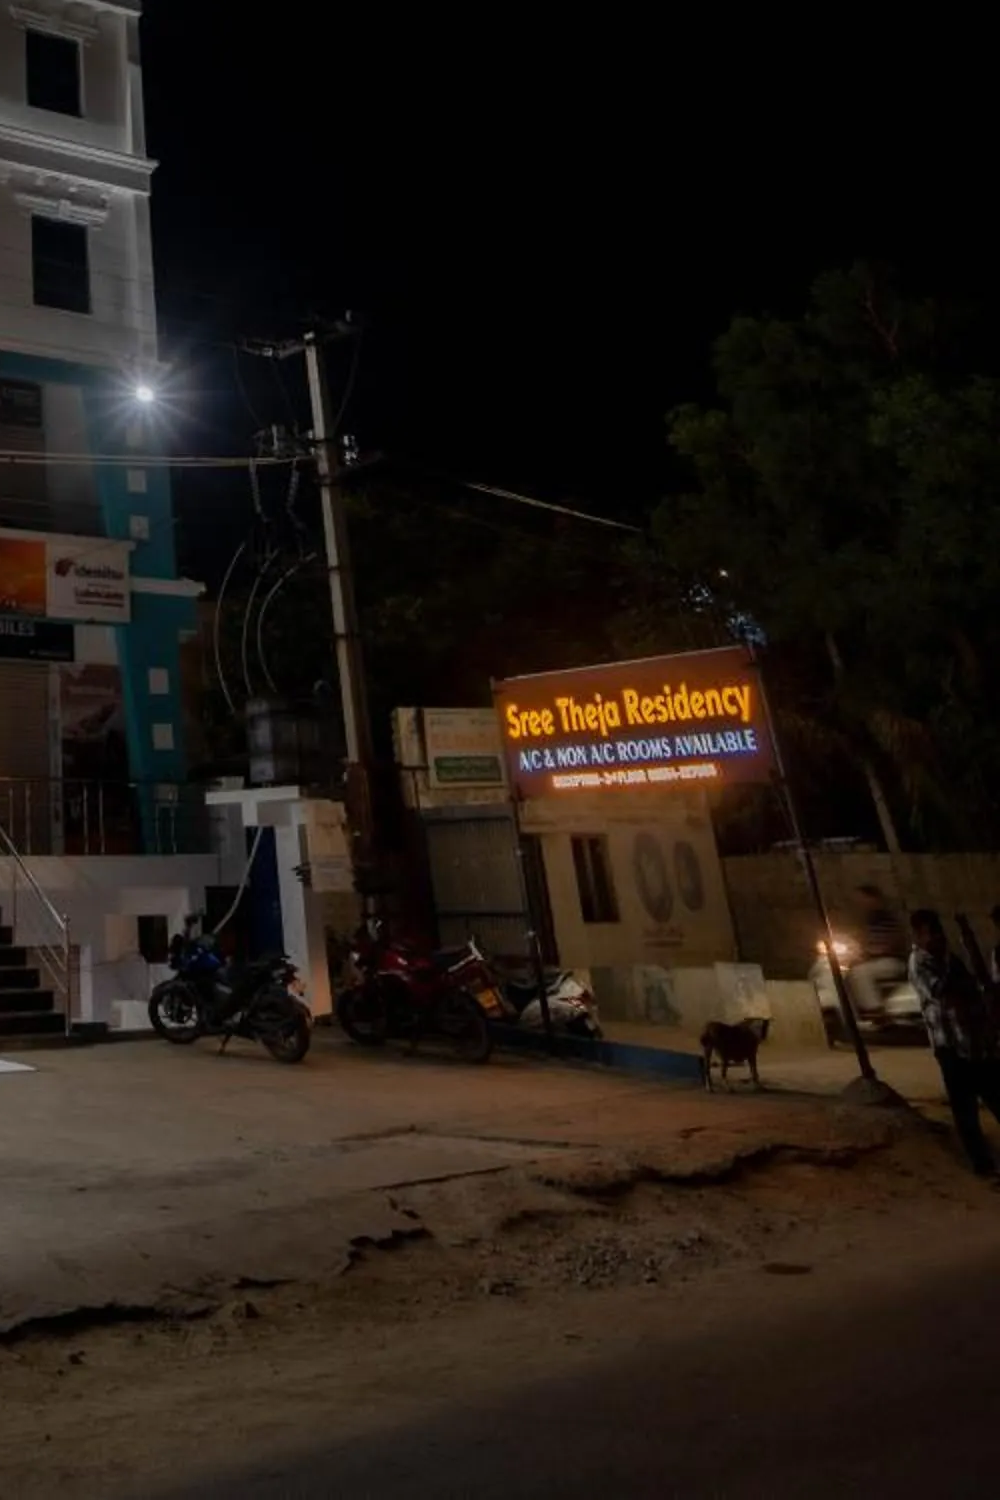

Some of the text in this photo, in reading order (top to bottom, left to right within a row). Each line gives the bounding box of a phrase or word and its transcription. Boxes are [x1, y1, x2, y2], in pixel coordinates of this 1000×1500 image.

[506, 681, 751, 740] Sree Theja Residency
[519, 748, 543, 772] A/C
[557, 743, 588, 767] NON
[591, 739, 616, 762] A/C
[618, 735, 672, 762] ROOMS
[675, 728, 758, 757] AVAILABLE
